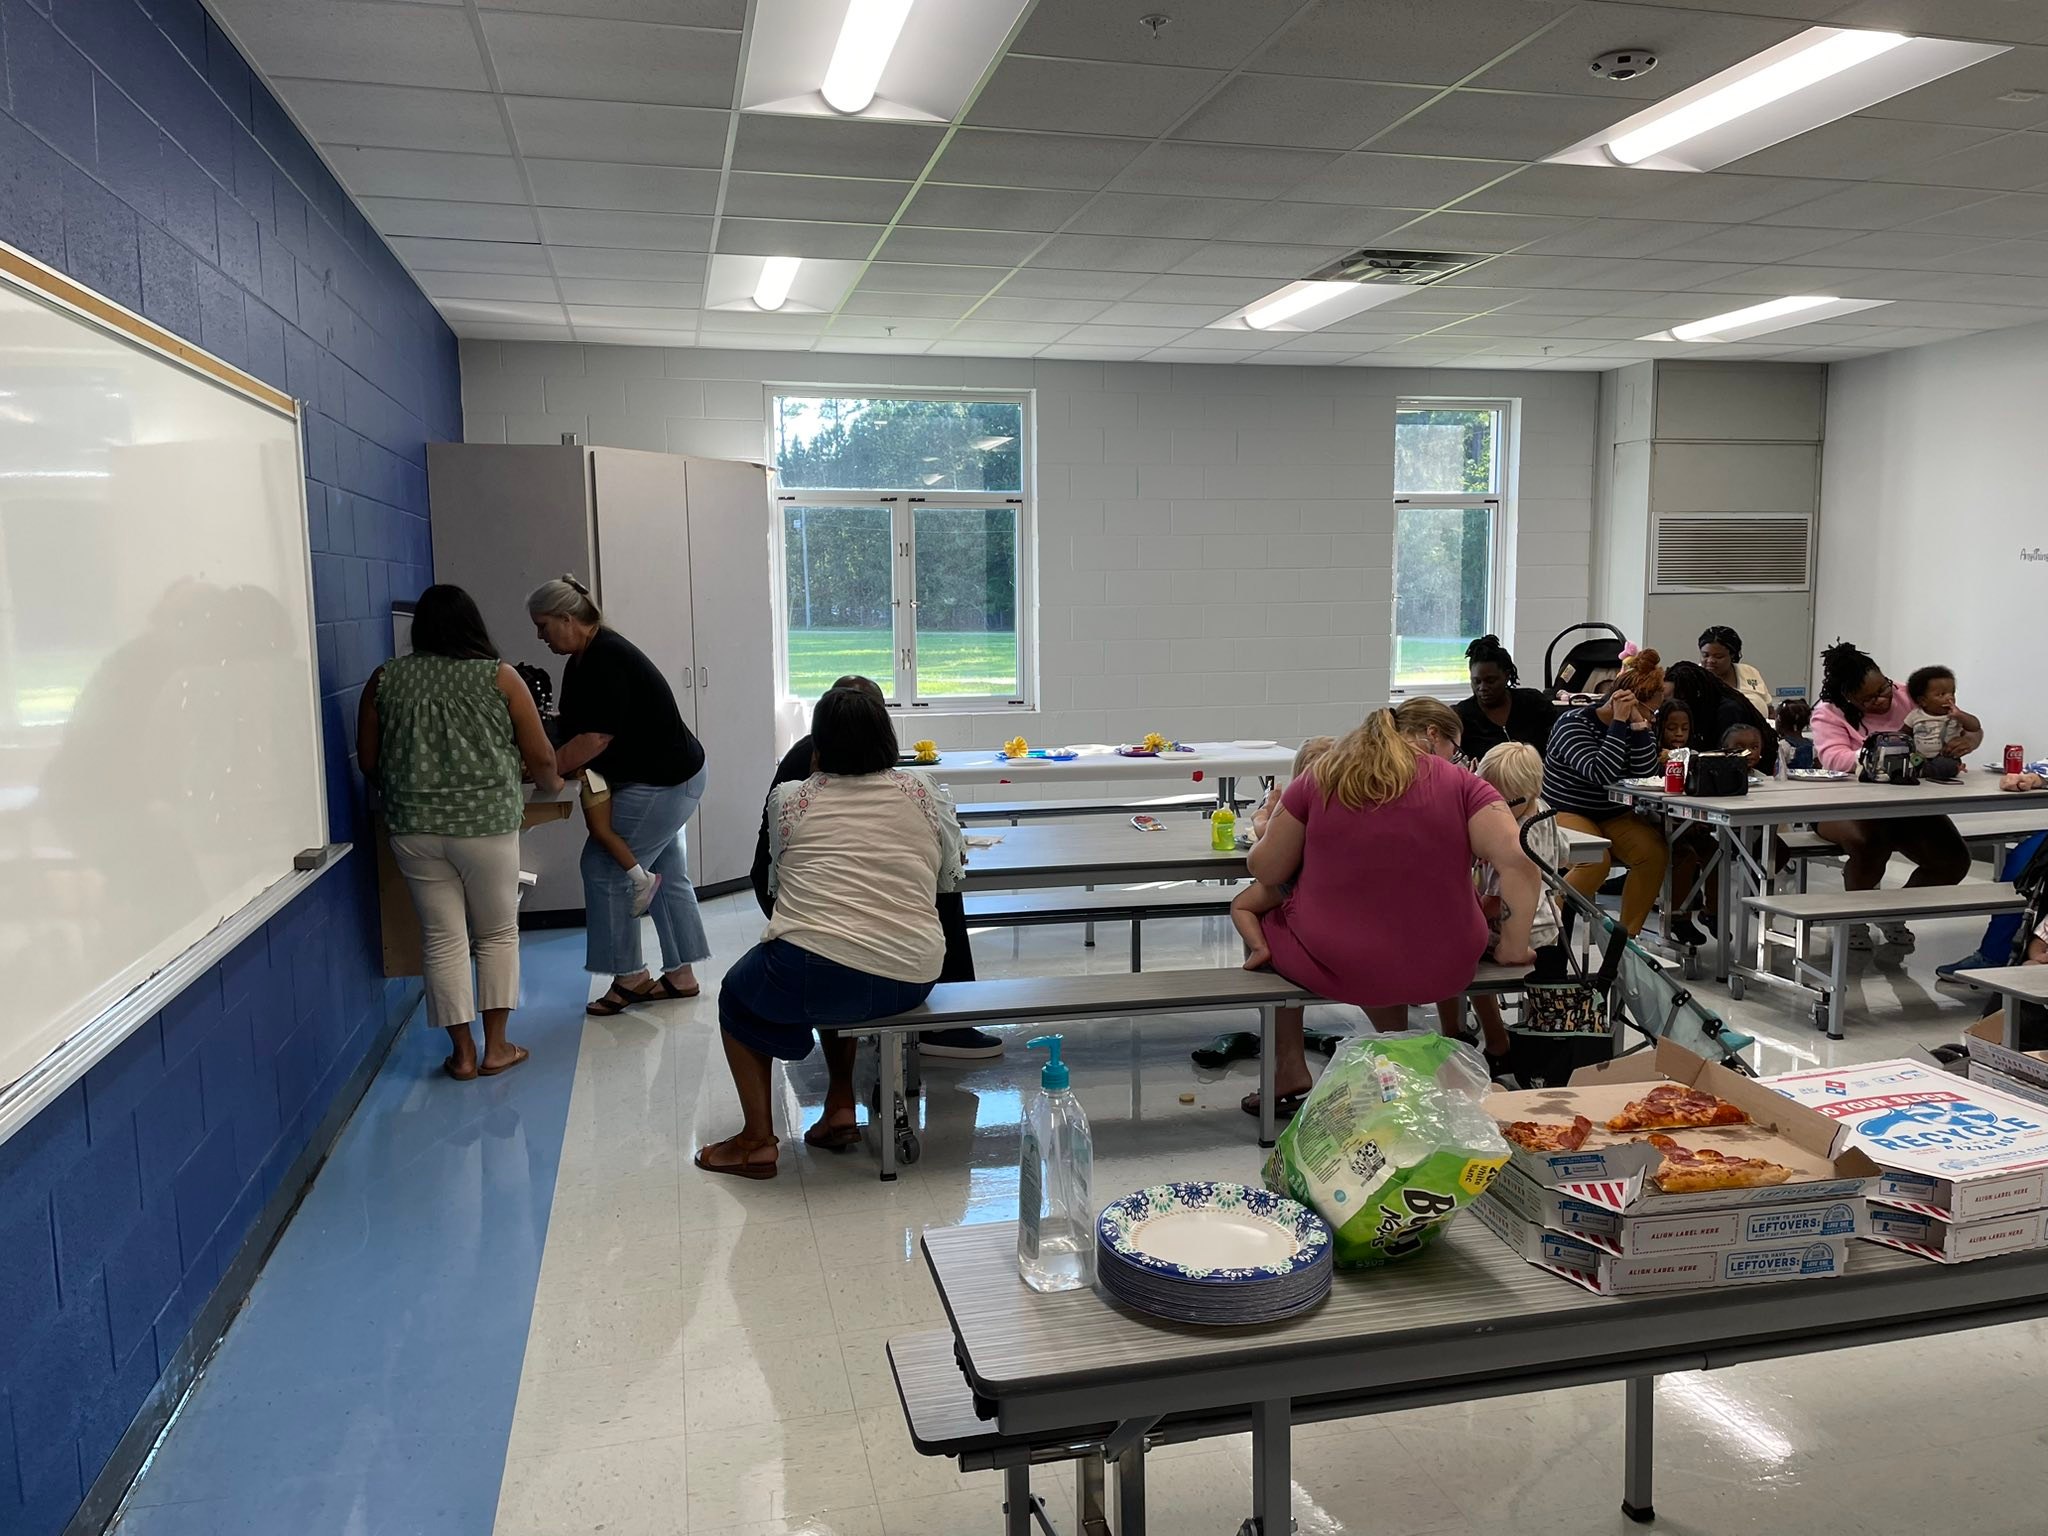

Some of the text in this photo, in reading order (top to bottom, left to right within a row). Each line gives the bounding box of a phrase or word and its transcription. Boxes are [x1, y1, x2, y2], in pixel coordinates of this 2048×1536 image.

[1841, 1099, 1885, 1112] YOUR
[1895, 1091, 1958, 1104] SLICE
[1869, 1117, 2040, 1151] RECYCLE
[1944, 1143, 1997, 1151] PIZZA
[1975, 1188, 2029, 1203] ALIGN LABEL HERE
[1751, 1217, 1821, 1233] LEFTOVERS:
[1651, 1227, 1720, 1240] ALIGN LABEL HERE
[1969, 1229, 2024, 1244] ALIGN LABEL HERE
[1628, 1264, 1697, 1276] ALIGN LABEL HERE
[1730, 1257, 1800, 1272] LEFTOVERS:
